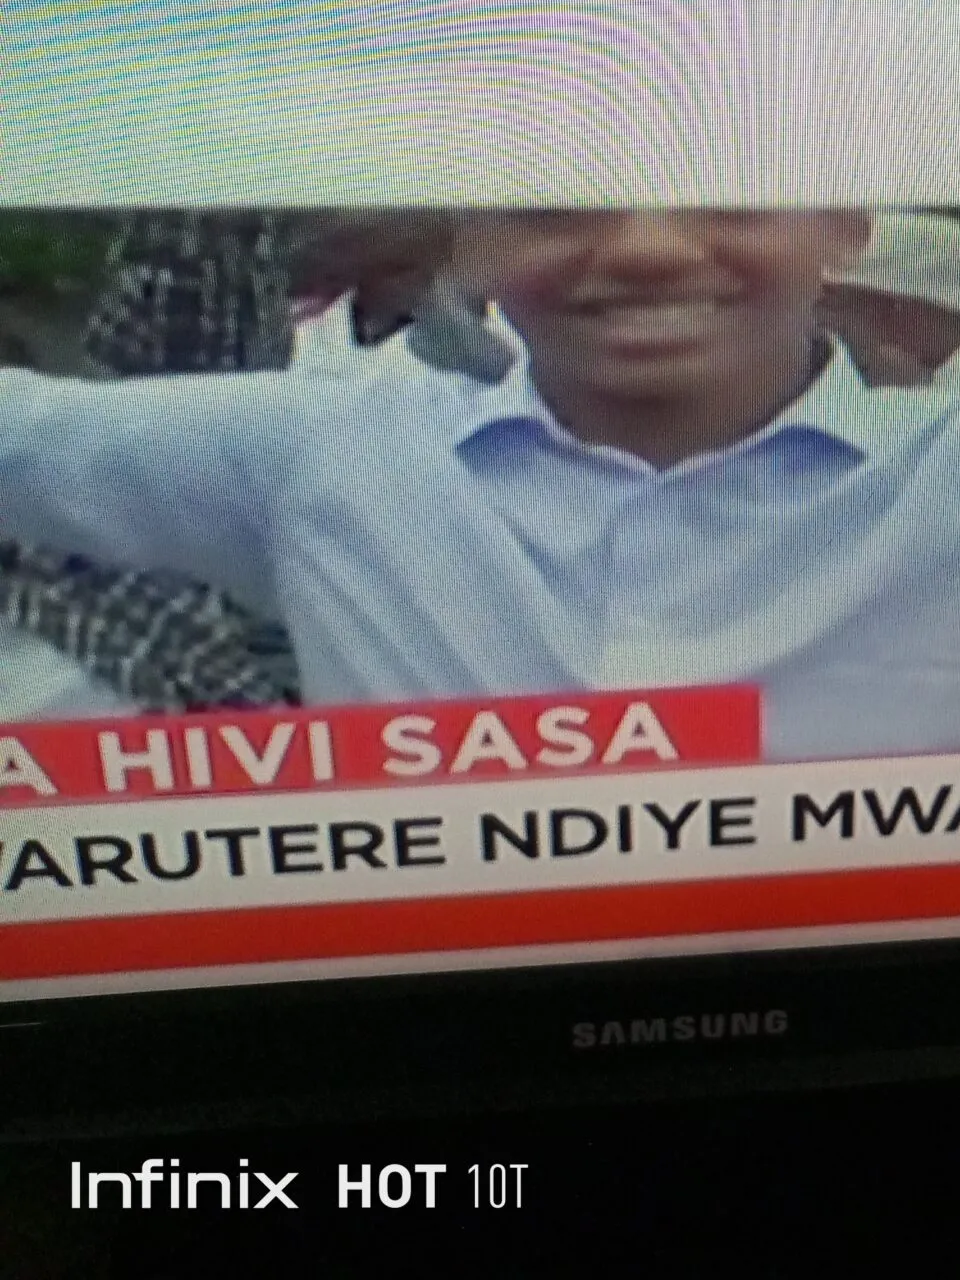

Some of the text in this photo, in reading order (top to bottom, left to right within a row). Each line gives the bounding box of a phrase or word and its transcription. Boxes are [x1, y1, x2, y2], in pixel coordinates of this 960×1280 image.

[98, 720, 334, 794] HIVI
[383, 700, 679, 778] SASA
[0, 816, 446, 891] ARUTERE
[481, 796, 757, 862] NDIYE
[572, 1009, 790, 1049] SAMSUNG
